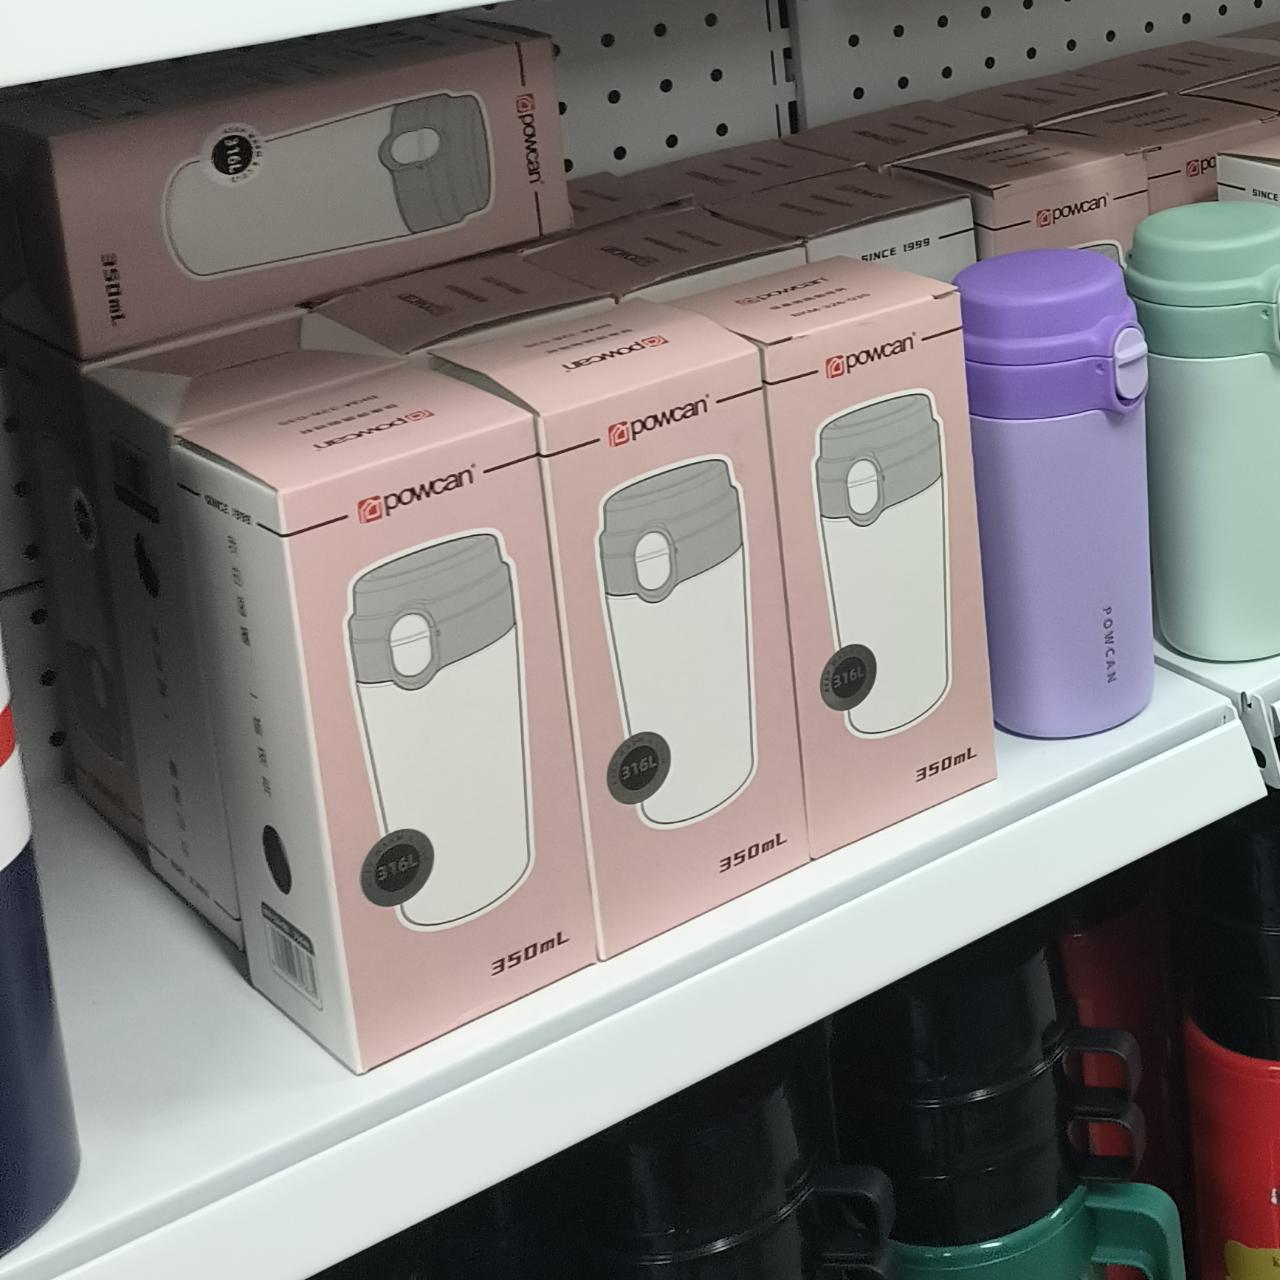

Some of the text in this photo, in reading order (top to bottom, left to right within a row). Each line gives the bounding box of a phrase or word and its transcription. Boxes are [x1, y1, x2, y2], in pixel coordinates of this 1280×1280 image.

[519, 113, 541, 184] powcan
[1051, 194, 1108, 226] powcan
[1252, 187, 1279, 203] SINCE
[861, 235, 931, 262] SINCE 1999
[562, 341, 646, 372] powcan
[846, 334, 914, 374] powcan
[313, 416, 408, 451] powcan
[631, 396, 708, 441] powcan
[384, 468, 474, 517] powcan
[1102, 606, 1118, 684] POWCAN
[833, 666, 865, 689] 316L
[621, 754, 660, 782] 316L
[915, 747, 978, 783] 350mL
[719, 832, 788, 874] 350mL
[491, 931, 571, 977] 350mL
